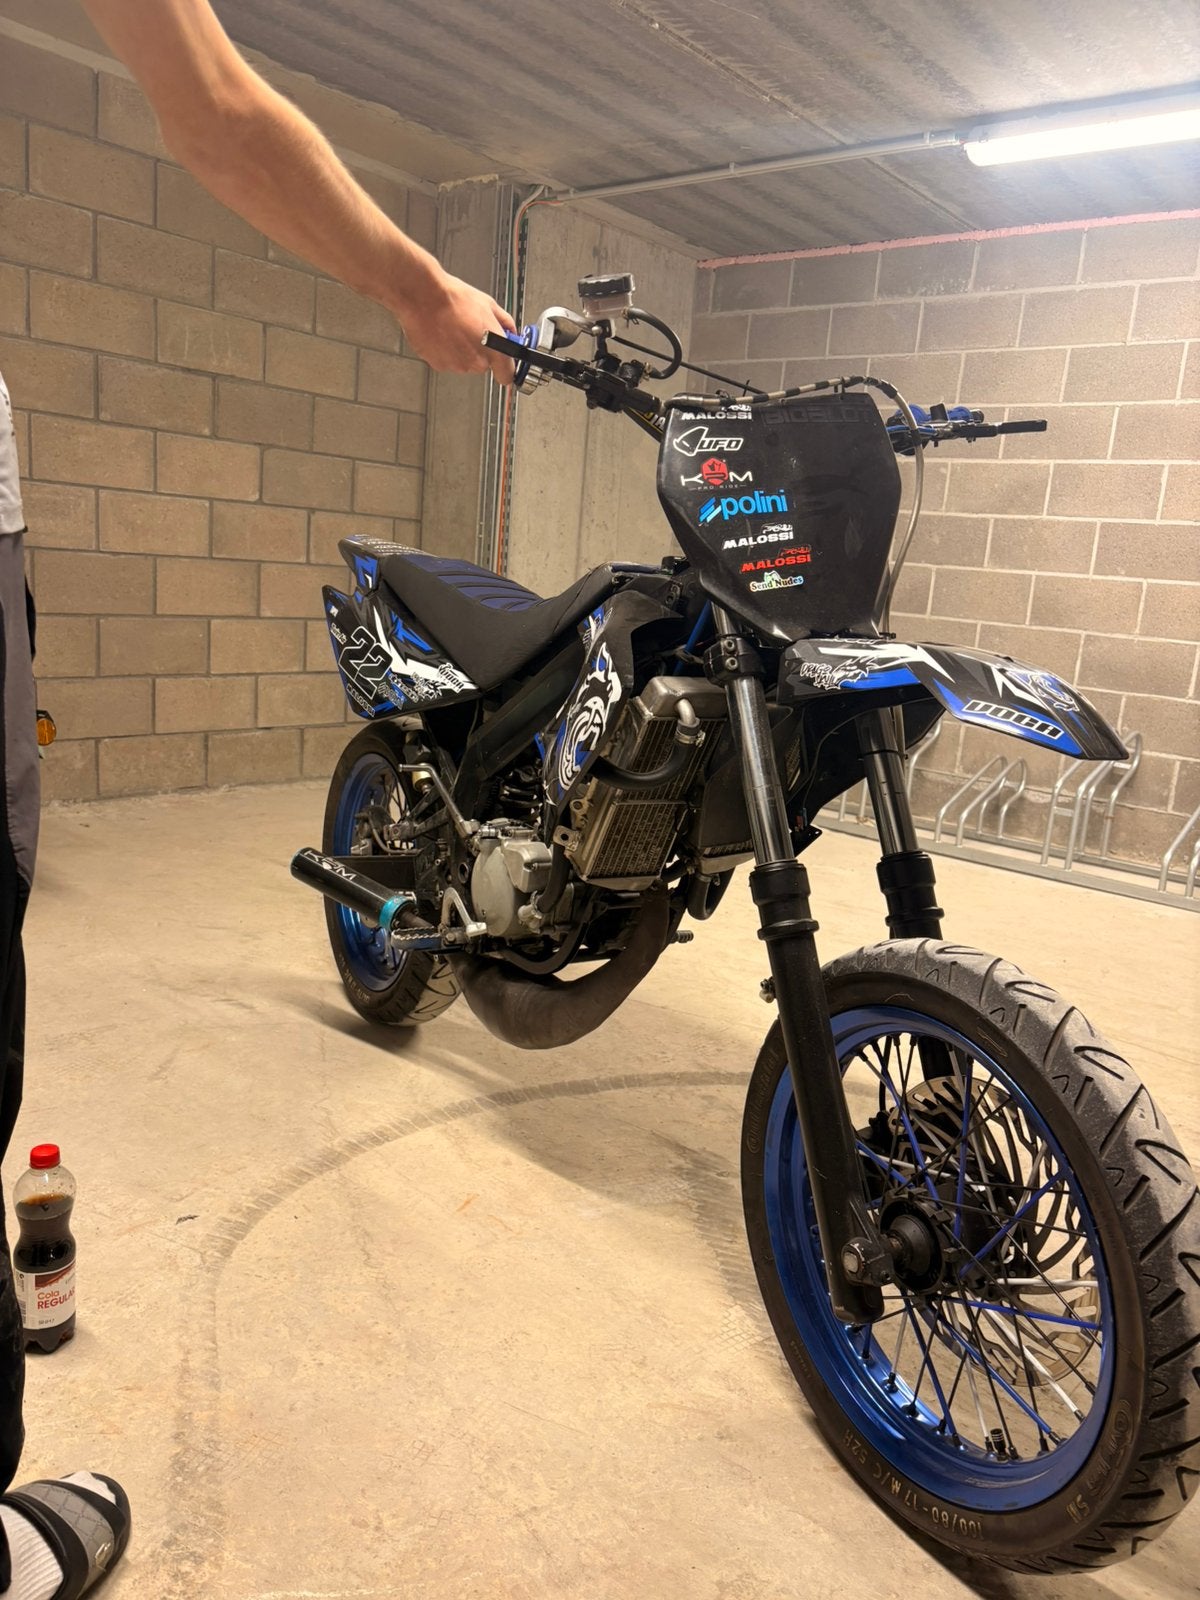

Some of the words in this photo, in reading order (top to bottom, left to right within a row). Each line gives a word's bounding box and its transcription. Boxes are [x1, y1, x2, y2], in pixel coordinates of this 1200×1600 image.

[681, 411, 753, 421] MALOSSI
[696, 437, 744, 452] UFO
[720, 489, 788, 520] polini
[723, 531, 794, 550] MALOSSI
[741, 554, 812, 572] MALOSSI
[751, 579, 772, 591] Send
[774, 576, 803, 587] Nudes
[338, 625, 393, 700] 22
[962, 699, 1065, 740] VOCA
[37, 1290, 60, 1300] Cola
